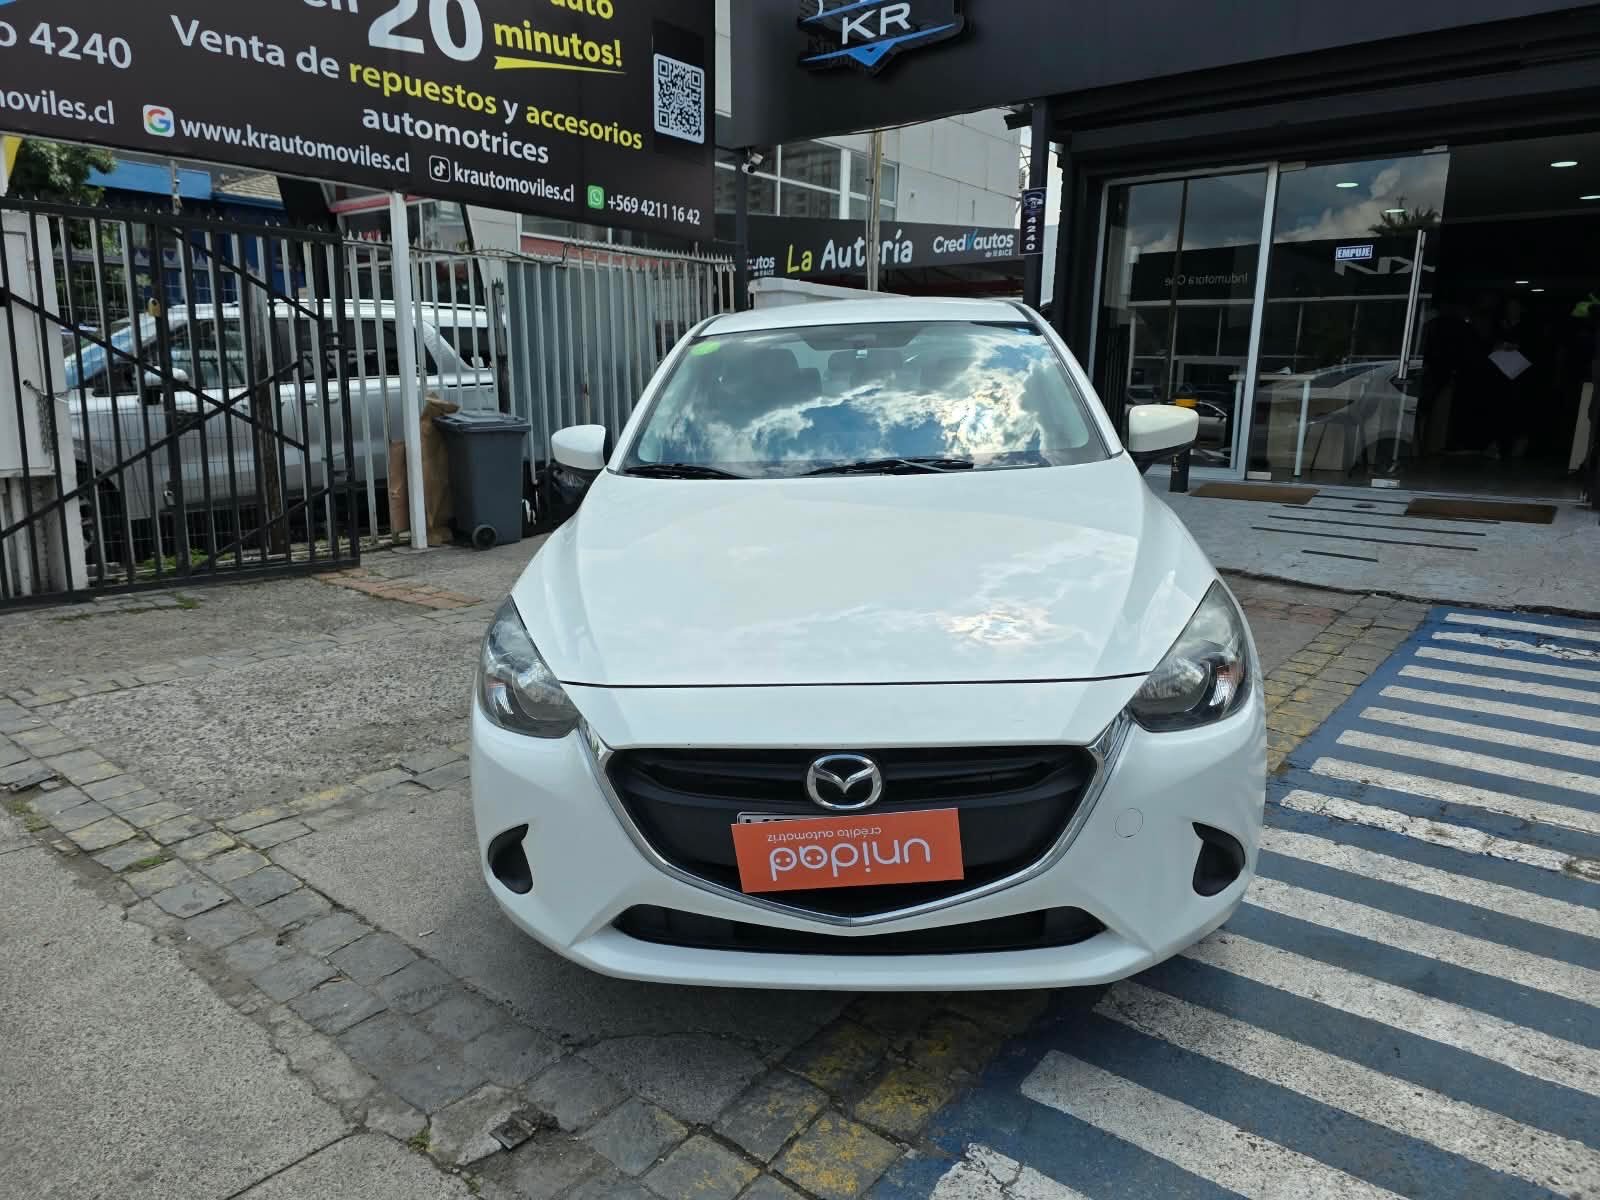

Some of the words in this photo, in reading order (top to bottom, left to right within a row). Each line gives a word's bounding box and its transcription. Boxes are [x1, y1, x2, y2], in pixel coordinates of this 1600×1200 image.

[29, 22, 132, 69] 4240
[494, 20, 622, 67] minutos!
[842, 3, 911, 45] KR
[170, 14, 286, 68] Venta
[296, 45, 340, 79] de
[349, 63, 498, 115] repuestos
[503, 99, 519, 124] y
[526, 105, 643, 150] accesorios
[0, 89, 115, 125] oviles.cl
[180, 118, 410, 173] www.krautomoviles.cl
[362, 108, 550, 164] automotrices
[454, 162, 575, 202] krautomoviles.cl
[607, 194, 639, 214] +569
[640, 199, 668, 220] 4211
[786, 243, 813, 274] La
[820, 229, 914, 271] Autría
[1337, 247, 1371, 258] EMPUJE
[767, 830, 834, 844] automotriz
[836, 826, 882, 840] crédito
[768, 837, 932, 882] unidad
